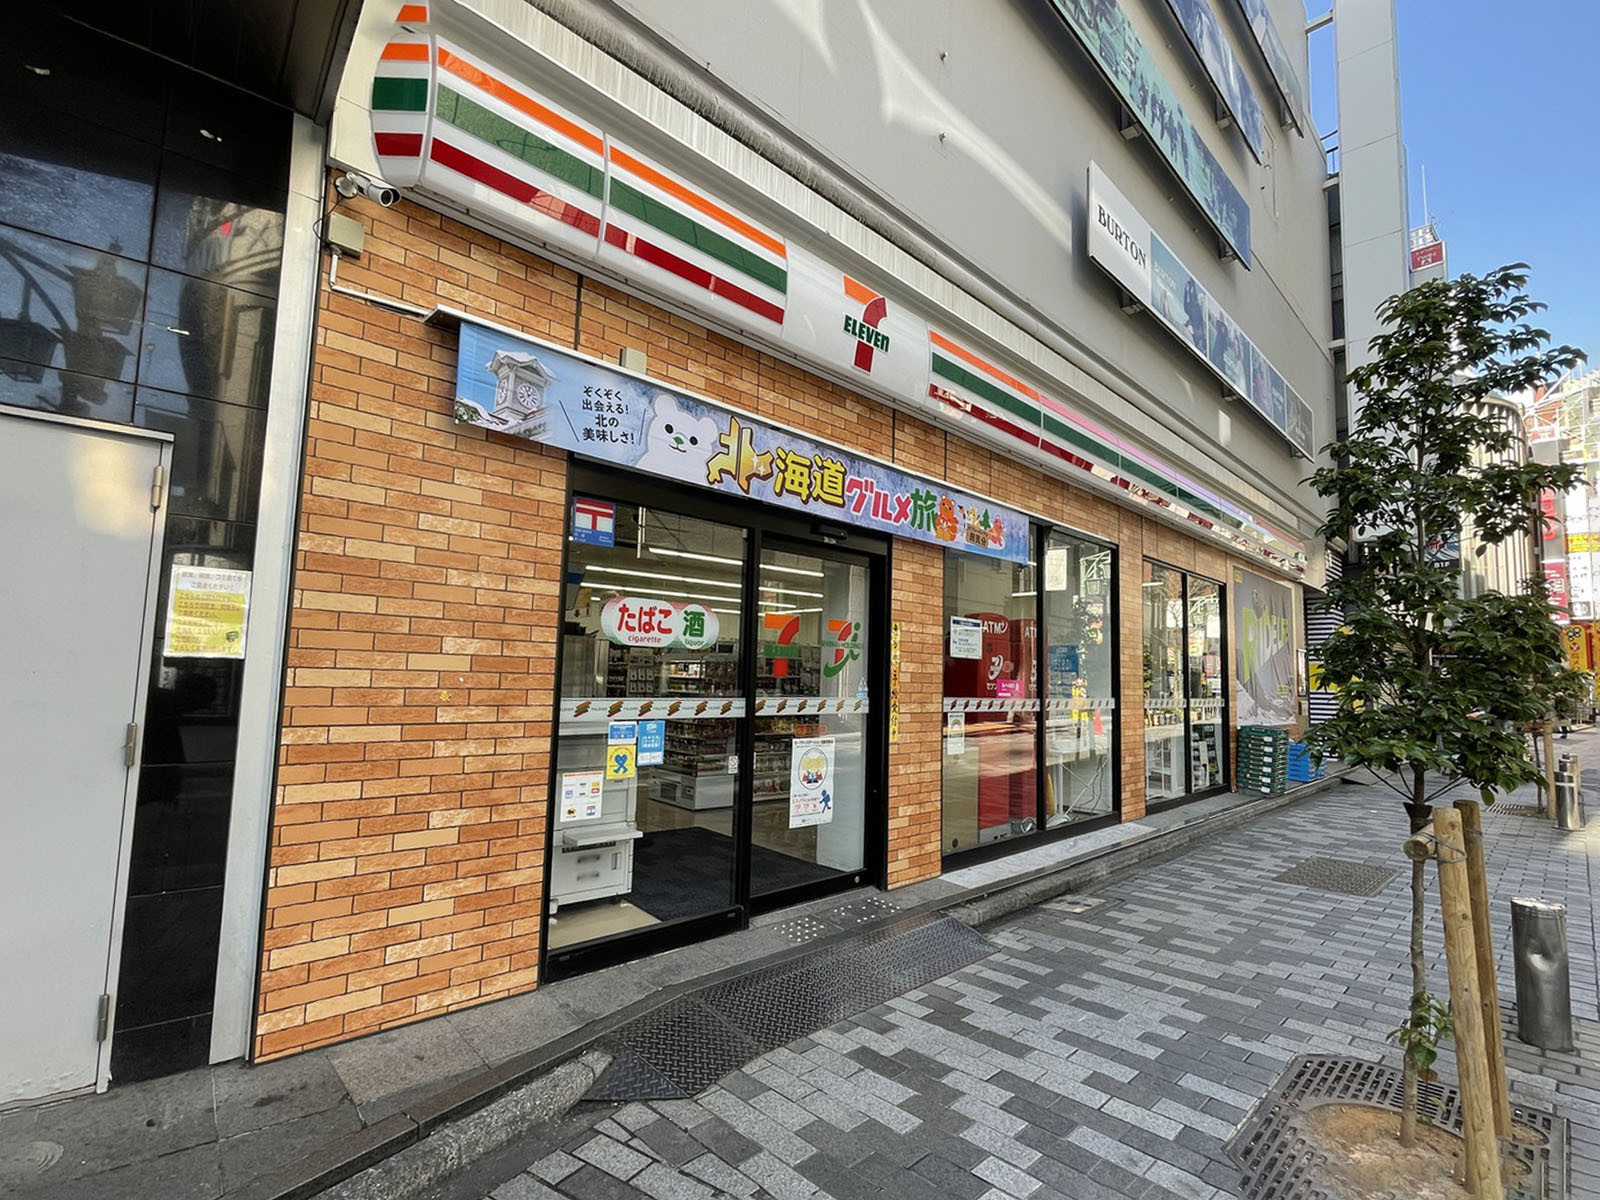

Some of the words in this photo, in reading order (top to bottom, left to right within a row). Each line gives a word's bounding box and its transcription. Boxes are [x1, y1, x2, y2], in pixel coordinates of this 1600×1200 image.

[1097, 204, 1146, 269] BURTON
[583, 386, 622, 401] ぞくぞく
[582, 399, 629, 415] 出会える!
[595, 414, 620, 428] 北の
[582, 427, 635, 445] 美味しさ!
[617, 603, 673, 634] たばこ
[682, 609, 706, 638] 酒
[983, 620, 1000, 634] ATM
[627, 635, 662, 643] cigarette
